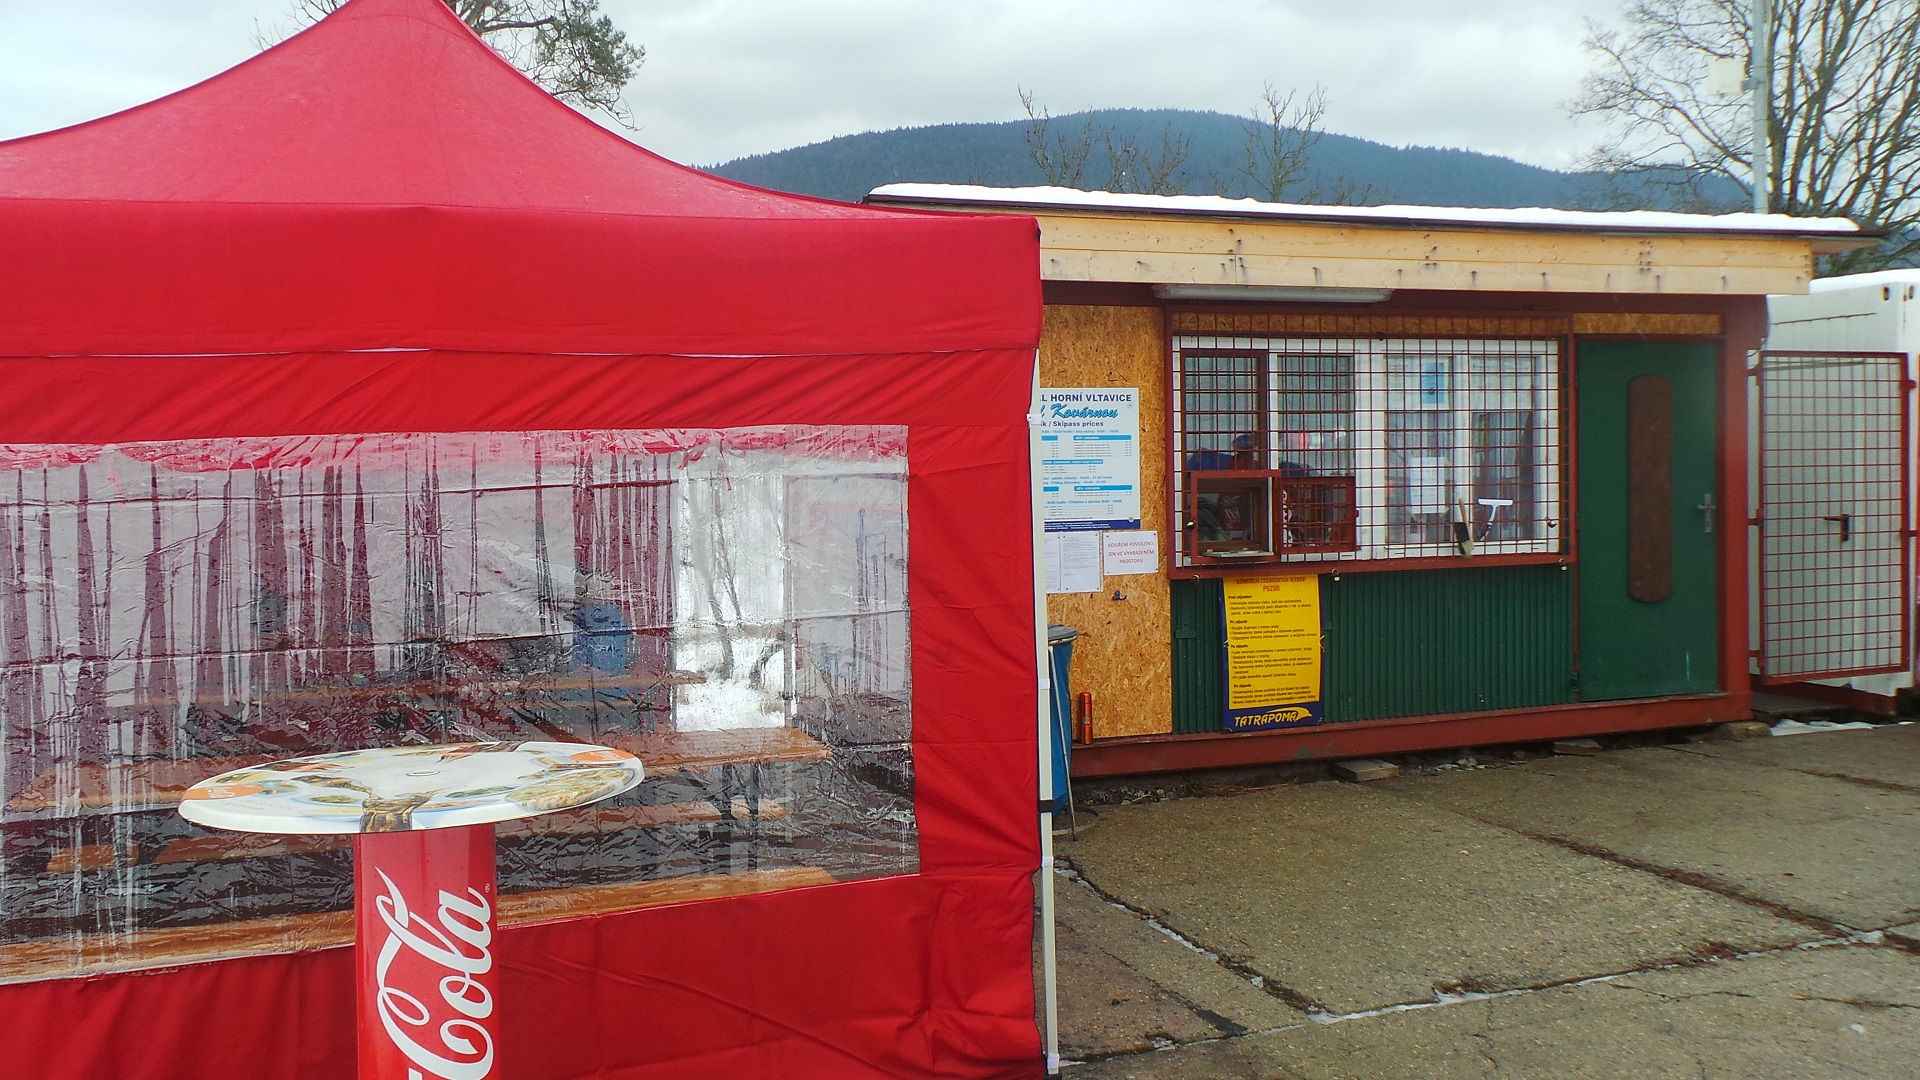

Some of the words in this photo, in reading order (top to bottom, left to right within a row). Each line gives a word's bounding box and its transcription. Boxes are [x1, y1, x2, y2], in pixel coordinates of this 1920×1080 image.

[1050, 392, 1083, 402] HORNÍ
[1086, 394, 1132, 402] VLTAVICE
[1050, 402, 1119, 419] Kovárnou
[1053, 420, 1081, 428] Skipass
[1082, 420, 1104, 428] prices
[1234, 711, 1299, 727] TATRAPOMA
